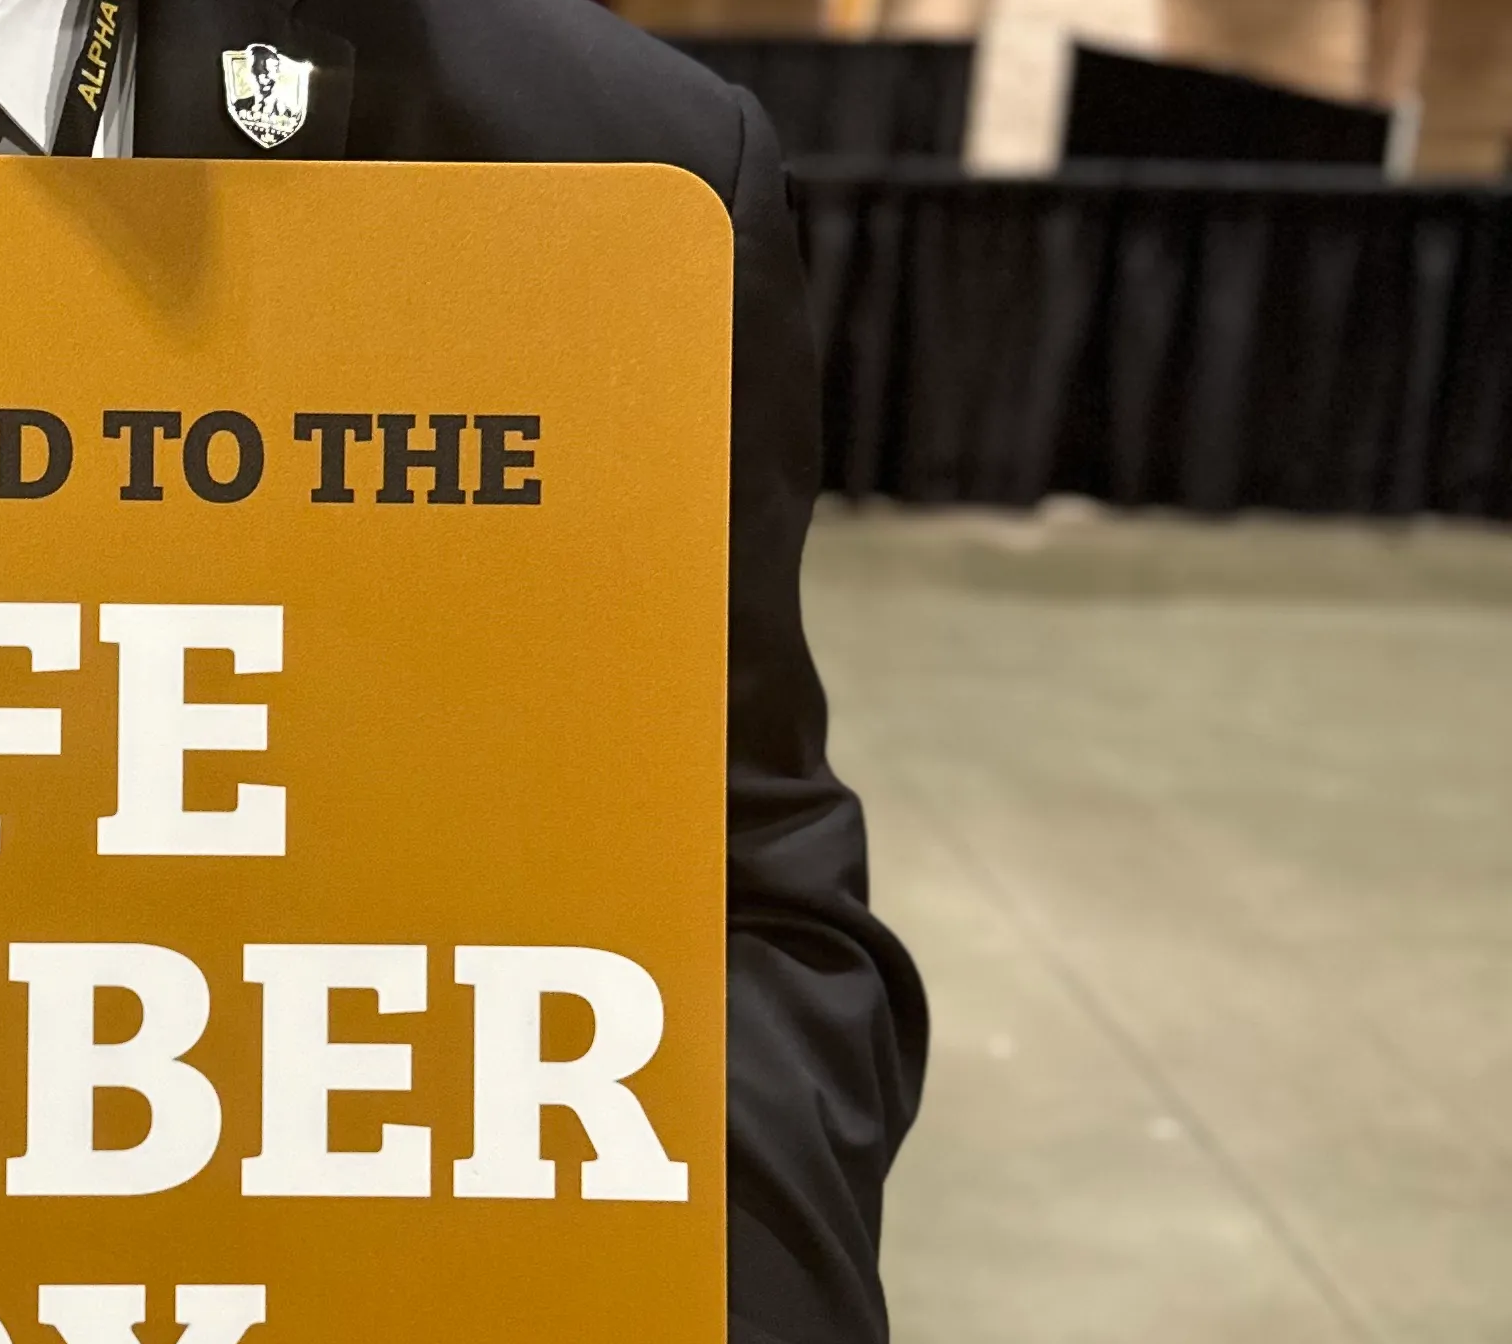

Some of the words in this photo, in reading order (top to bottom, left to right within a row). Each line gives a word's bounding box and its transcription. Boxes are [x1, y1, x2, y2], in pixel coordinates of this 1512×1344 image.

[77, 1, 119, 111] ALPHA
[102, 410, 265, 504] TO
[293, 412, 542, 506] THE
